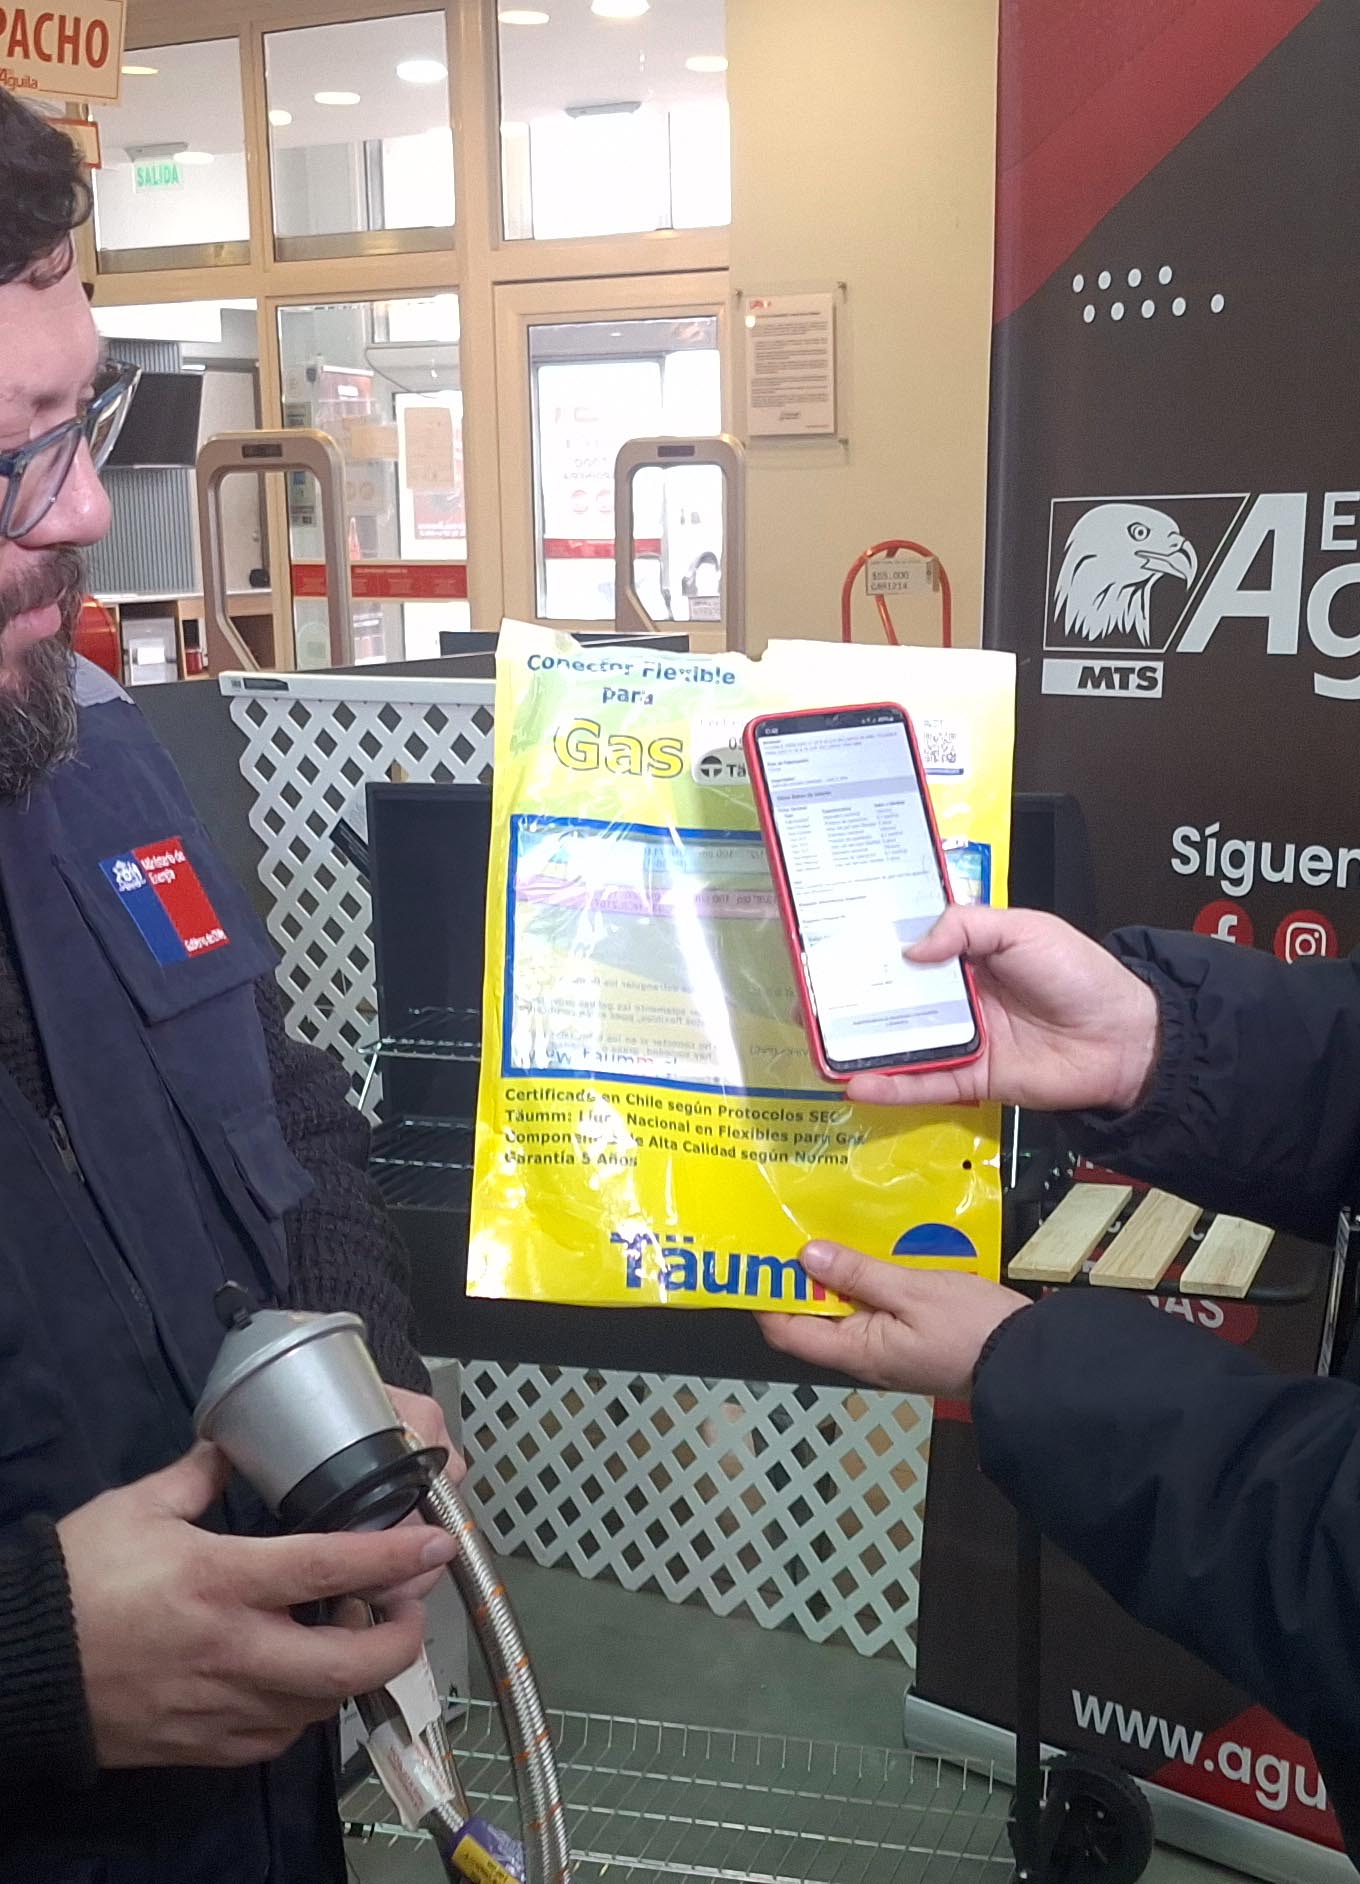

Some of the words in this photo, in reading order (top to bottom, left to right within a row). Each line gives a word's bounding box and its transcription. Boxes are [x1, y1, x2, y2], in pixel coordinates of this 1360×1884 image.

[136, 163, 179, 188] SALIDA
[1077, 665, 1159, 692] MTS
[553, 715, 685, 779] Gas
[626, 1092, 663, 1110] Chile
[668, 1101, 712, 1116] según
[718, 1105, 803, 1122] Protocolos
[506, 1109, 572, 1123] Täumm:
[626, 1112, 690, 1133] Nacional
[695, 1124, 713, 1137] en
[718, 1124, 788, 1142] Flexibles
[504, 1149, 575, 1166] Garantía
[597, 1151, 638, 1168] Años
[648, 1136, 678, 1151] Alta
[682, 1140, 736, 1159] Calidad
[740, 1146, 788, 1164] según
[794, 1150, 849, 1165] Norma
[610, 1230, 837, 1303] Täum
[1071, 1687, 1329, 1811] www.agu
